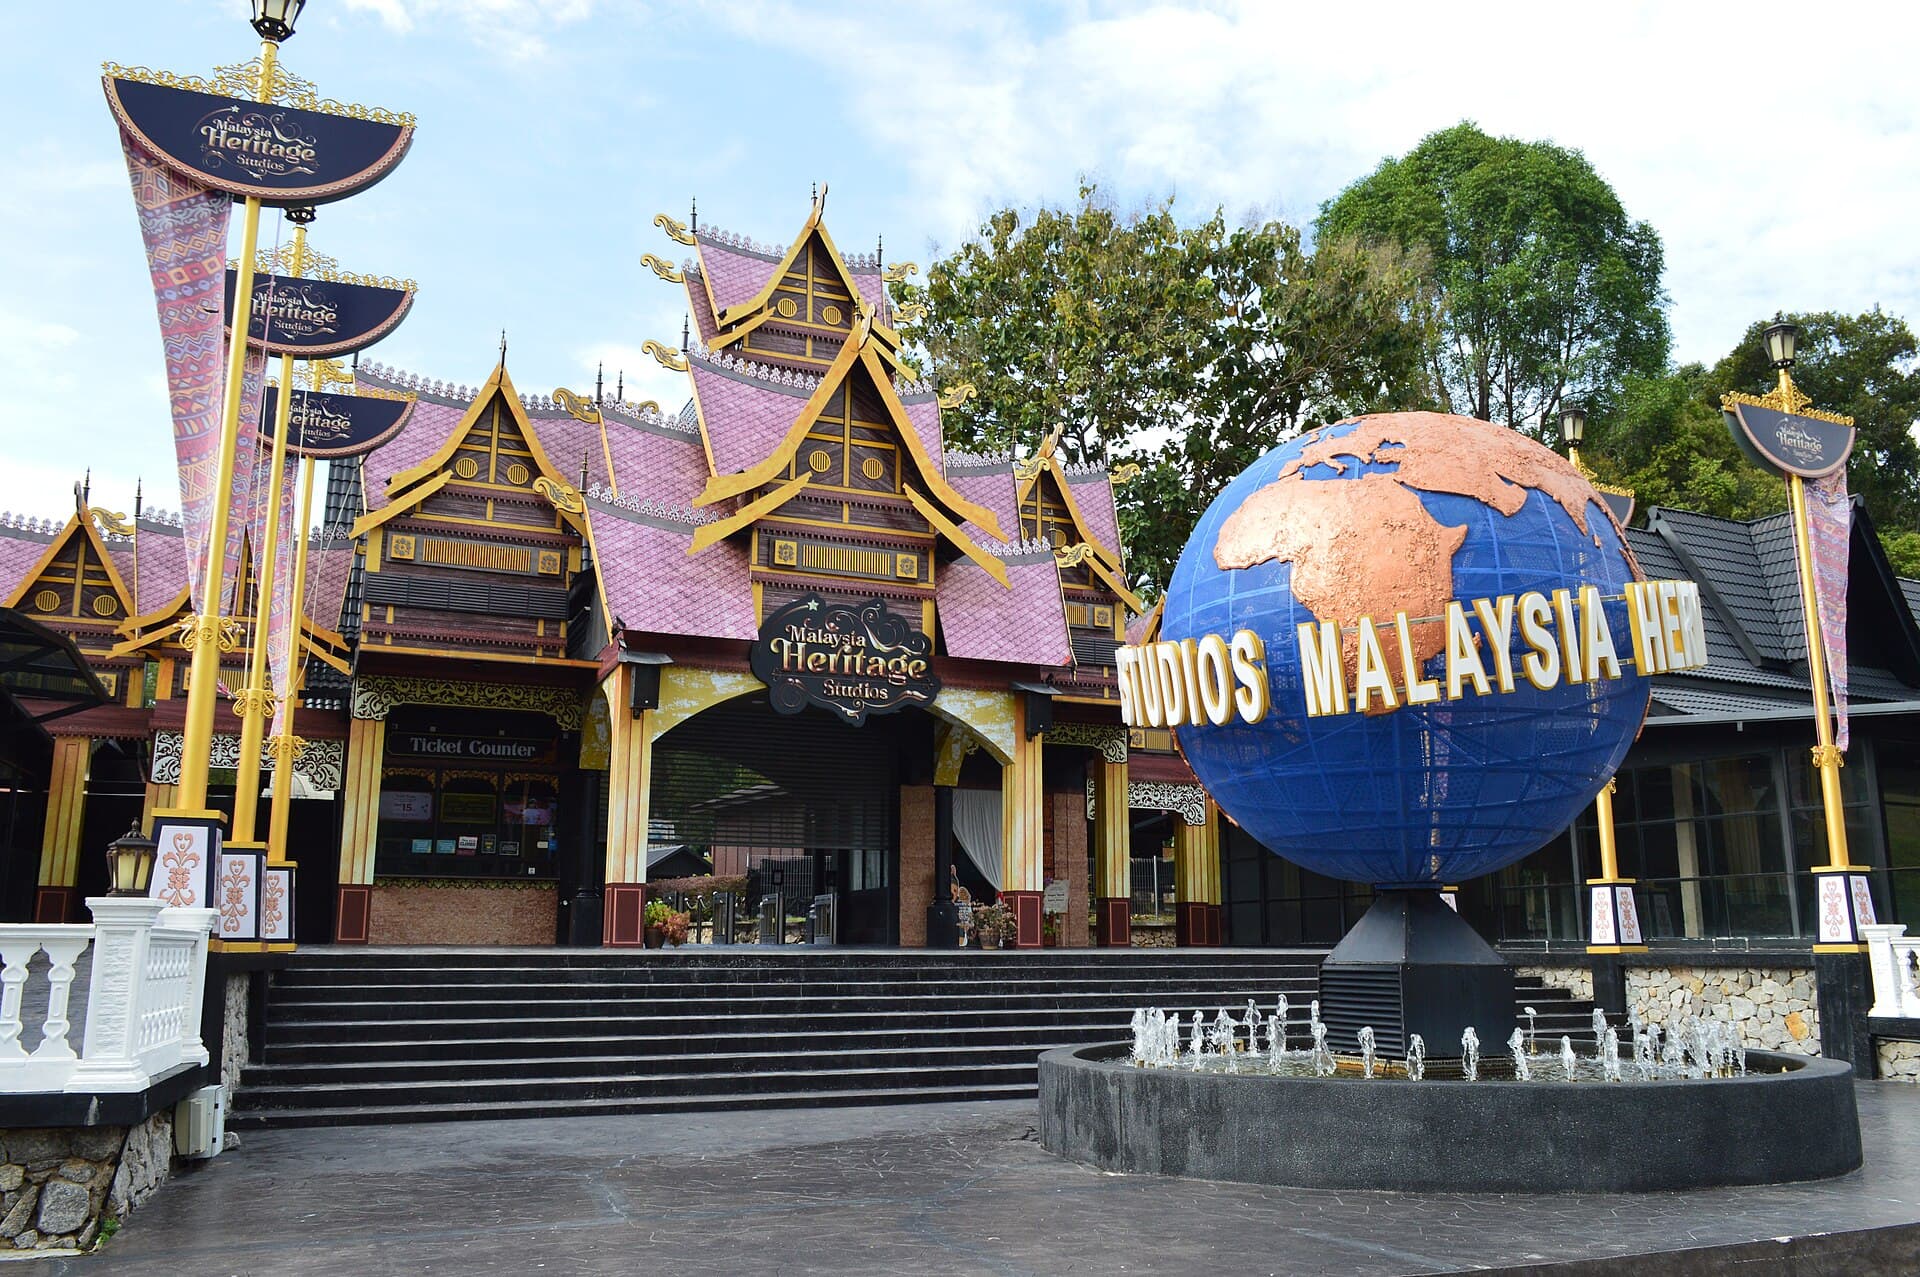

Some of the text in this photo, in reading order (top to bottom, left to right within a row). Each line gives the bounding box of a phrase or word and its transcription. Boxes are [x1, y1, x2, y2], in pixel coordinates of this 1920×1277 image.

[213, 118, 272, 138] Malaysia
[201, 125, 316, 164] Heritage
[236, 153, 285, 171] Studios
[250, 298, 337, 326] Heritage
[1775, 430, 1822, 454] Heritage
[785, 624, 866, 648] Malaysia
[770, 637, 928, 686] Heritage
[1114, 629, 1269, 727] STUDIOS
[1297, 585, 1622, 717] MALAYSIA
[823, 678, 889, 700] Studios
[409, 736, 536, 757] Ticket Counter
